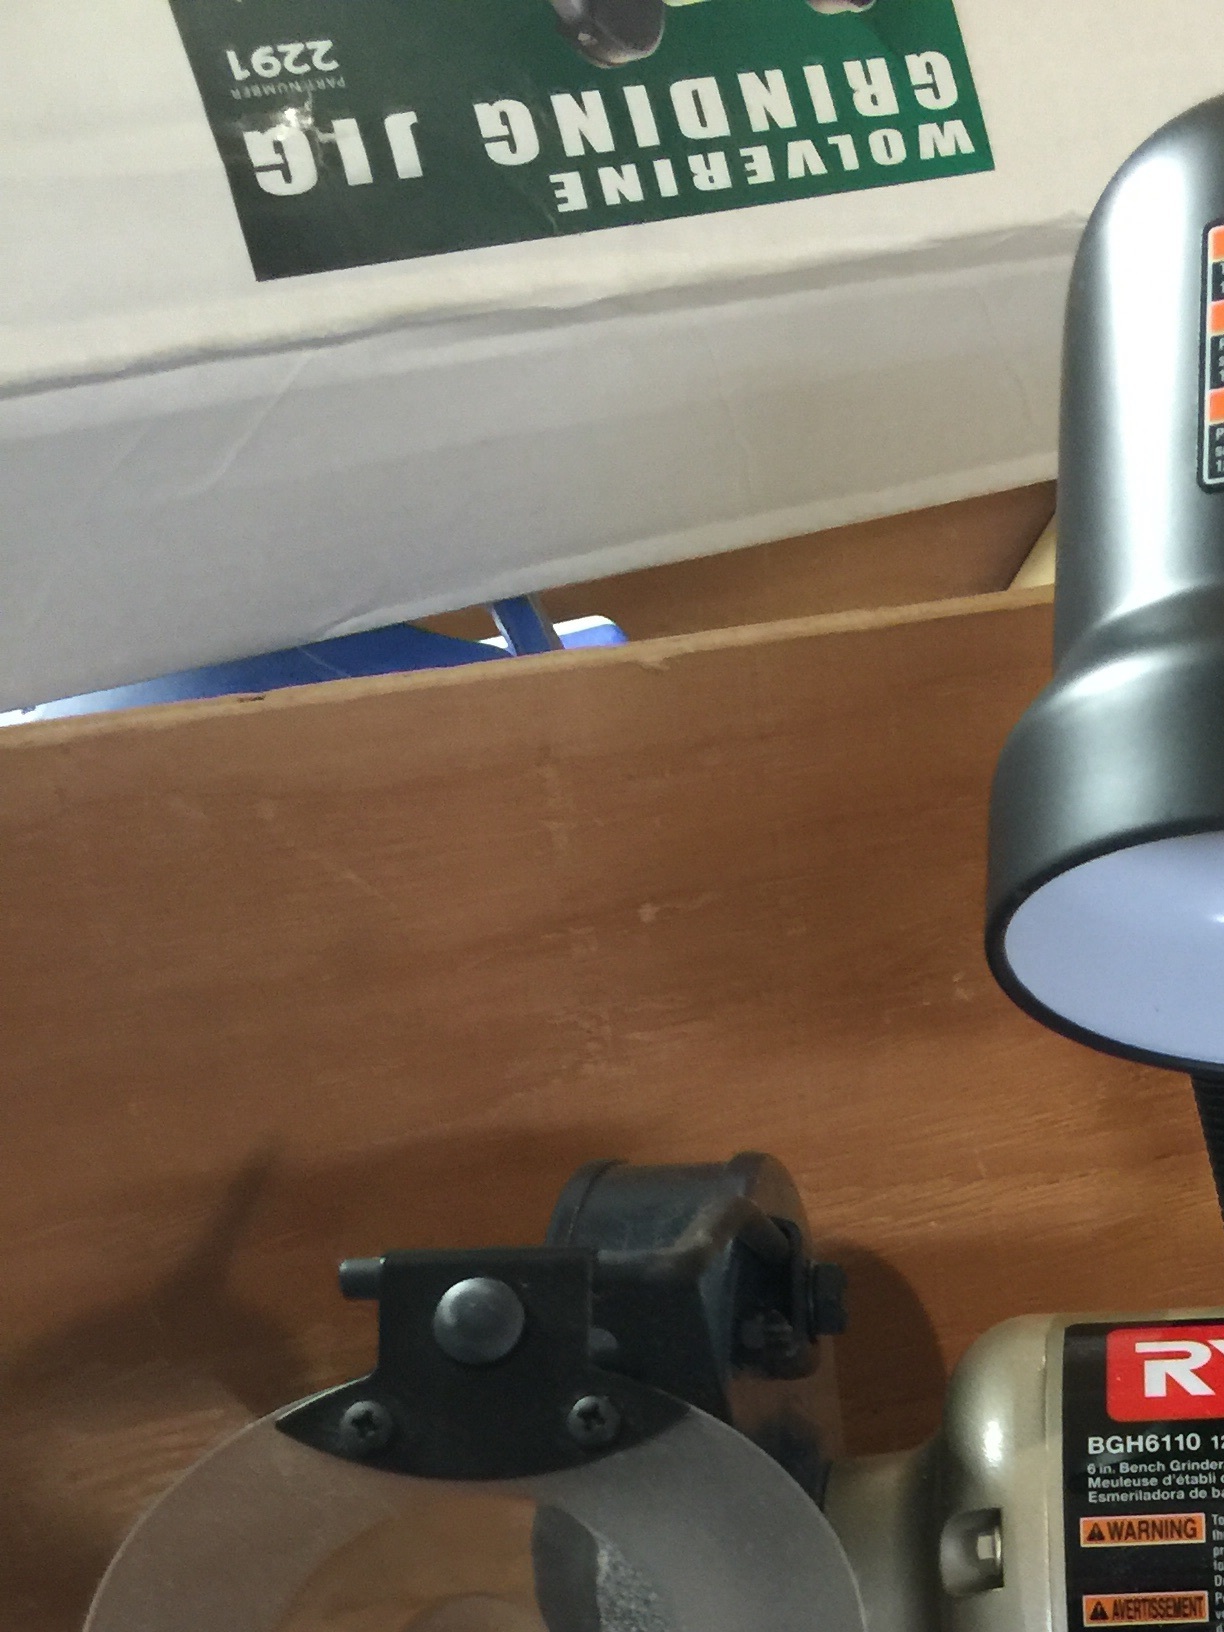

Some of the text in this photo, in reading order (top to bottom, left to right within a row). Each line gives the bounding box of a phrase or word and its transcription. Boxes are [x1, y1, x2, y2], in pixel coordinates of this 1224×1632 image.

[226, 40, 340, 81] 2291
[243, 51, 958, 196] GRINDING JIG
[550, 119, 975, 213] WOLVERINE
[1087, 1433, 1201, 1454] BGH6110
[1087, 1463, 1096, 1474] 6
[1100, 1464, 1116, 1474] in.
[1119, 1462, 1166, 1474] Bench
[1088, 1476, 1158, 1488] Meuleuse
[1162, 1473, 1216, 1486] d'établi
[1088, 1490, 1185, 1503] Esmeriladora
[1189, 1488, 1207, 1499] de
[1107, 1519, 1197, 1541] WARNING
[1212, 1514, 1224, 1526] To
[1113, 1596, 1204, 1620] AVERTISSEMENT
